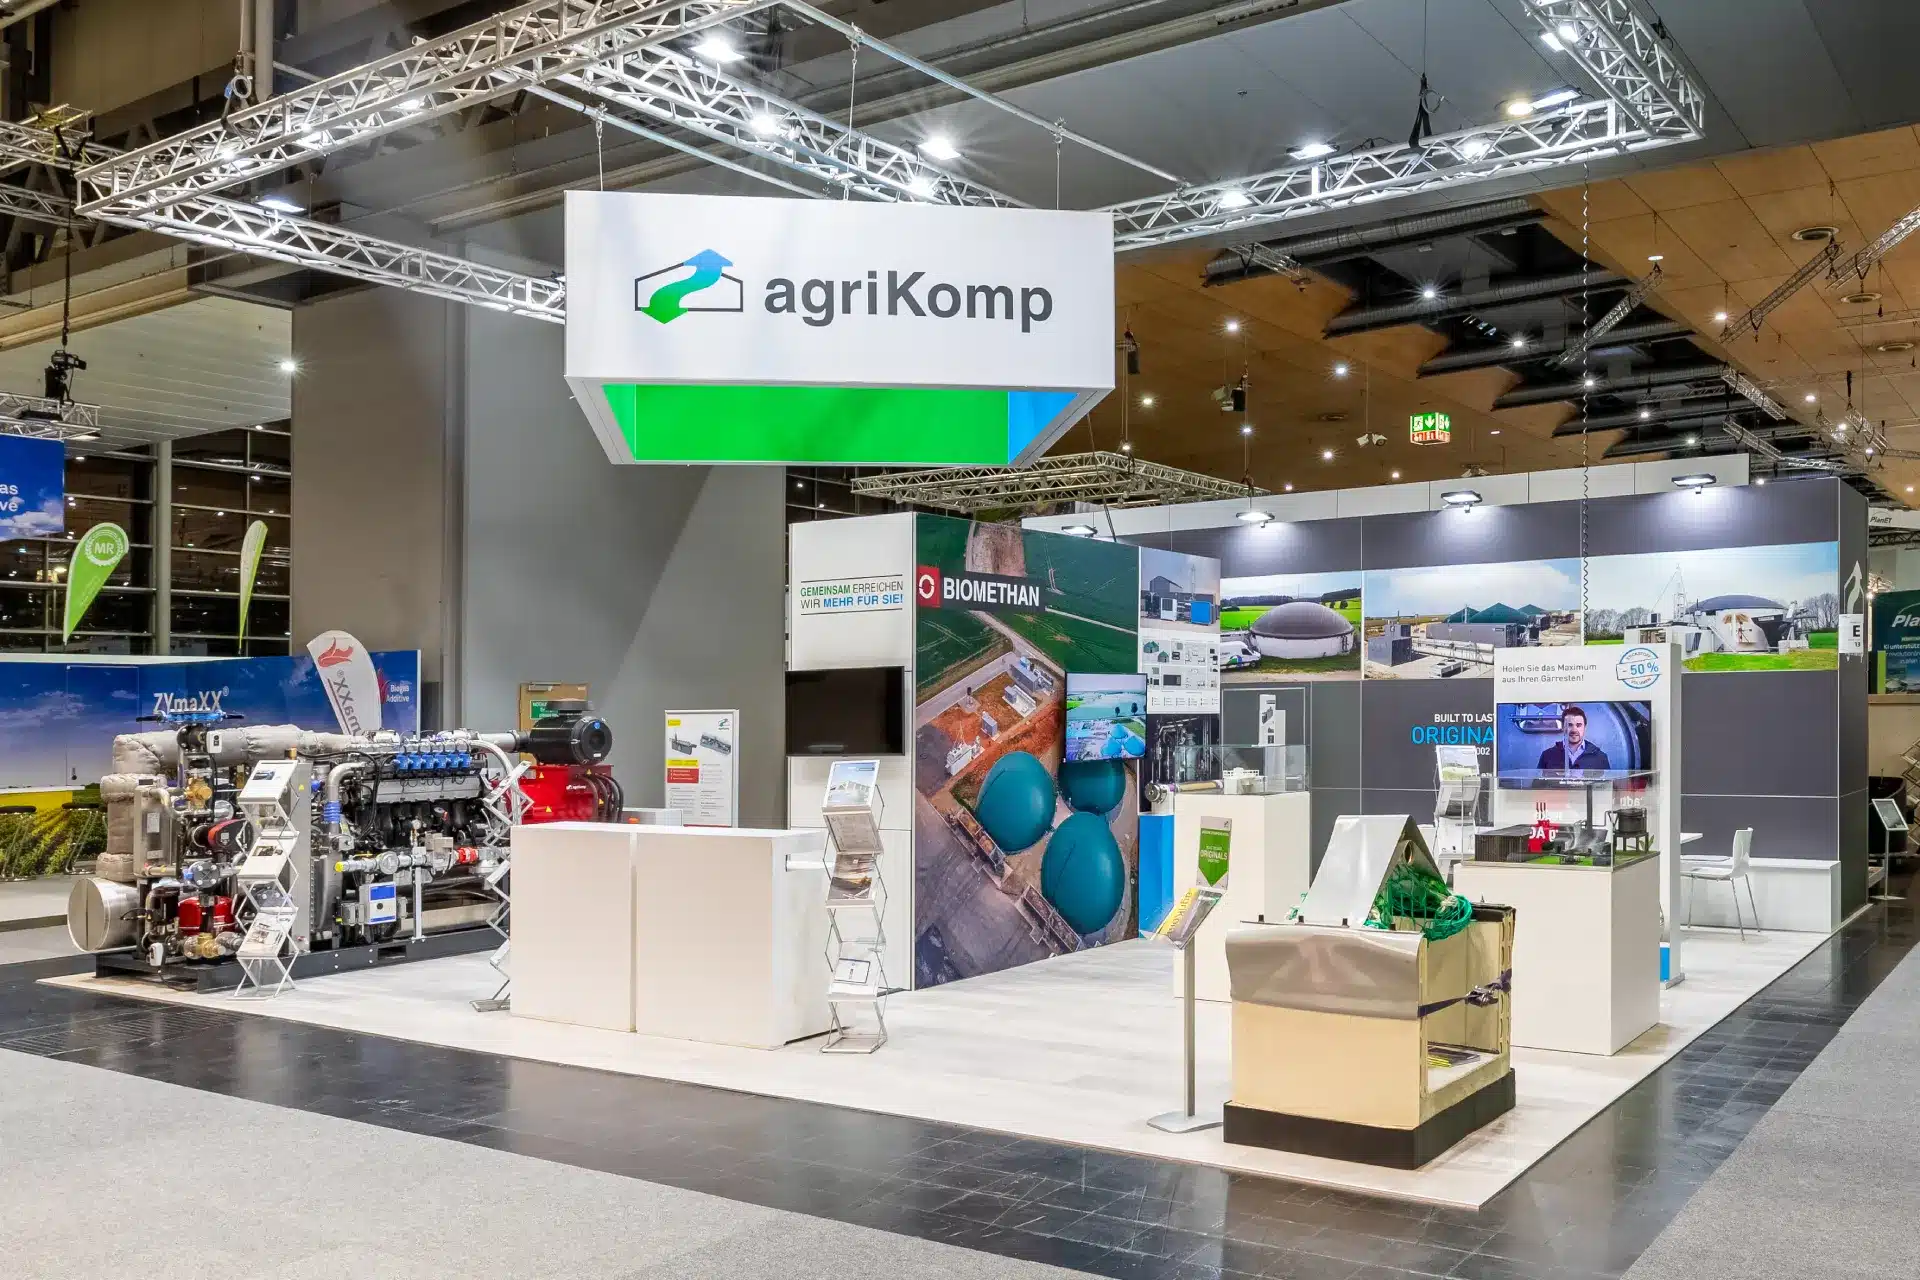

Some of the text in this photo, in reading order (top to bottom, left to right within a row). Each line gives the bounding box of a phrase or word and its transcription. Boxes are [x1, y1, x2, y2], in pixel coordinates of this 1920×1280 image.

[764, 270, 1053, 333] agriKomp
[94, 542, 115, 555] MR
[800, 580, 904, 597] GEMEINSAM ERREICHEN
[943, 577, 1040, 607] BIOMETHAN
[800, 592, 904, 609] WIR MEHR FÜR SIE!
[1891, 614, 1920, 628] Pla
[1853, 625, 1860, 637] E
[1502, 663, 1597, 673] Holen Sie das Maximum
[1630, 663, 1645, 675] 50
[1518, 675, 1539, 683] Ihren
[1434, 714, 1460, 723] BUILT
[1461, 714, 1474, 723] TO
[1411, 725, 1494, 744] ORIGINA
[1476, 747, 1491, 755] 002
